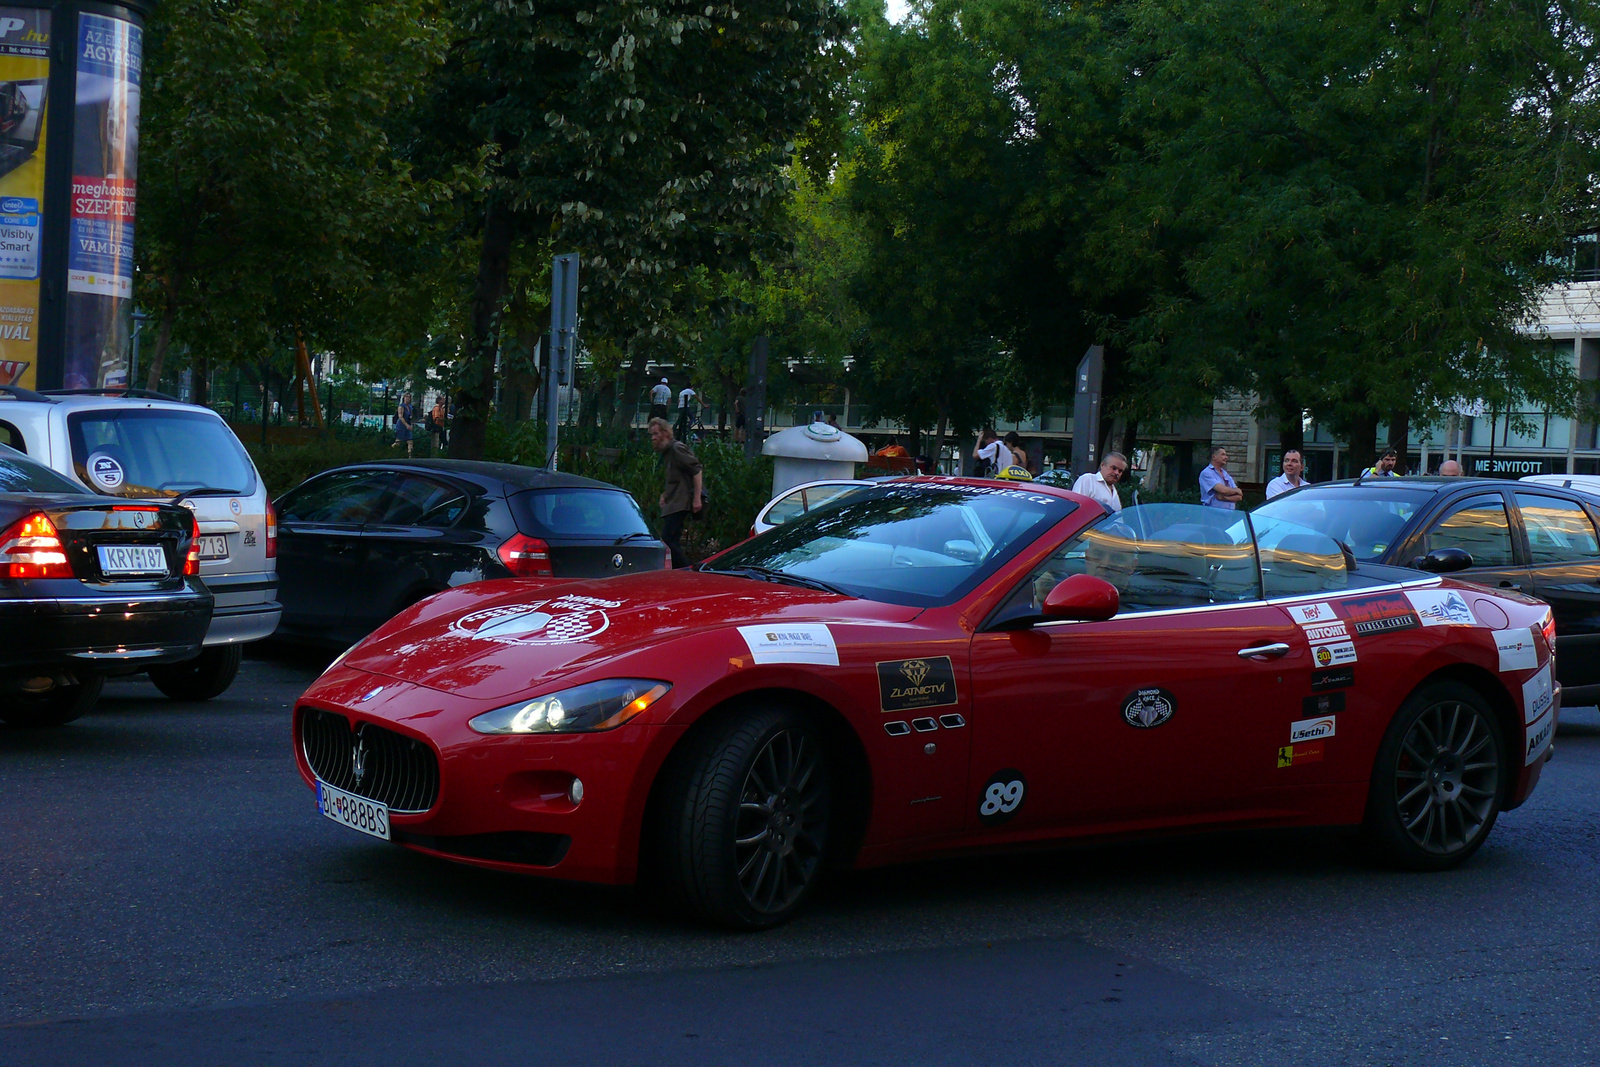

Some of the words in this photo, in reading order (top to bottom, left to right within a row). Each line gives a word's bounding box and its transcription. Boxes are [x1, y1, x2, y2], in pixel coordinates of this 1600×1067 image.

[1, 229, 34, 242] Visibly
[1, 242, 30, 252] Smart
[1008, 469, 1030, 478] TAXI
[1475, 459, 1543, 474] MEGNYITOTT
[199, 537, 225, 555] 713
[1302, 604, 1321, 620] hey!
[1355, 620, 1384, 633] FITNESS
[1387, 615, 1414, 628] CENTER
[1306, 625, 1348, 640] AUTOHIT
[1317, 651, 1331, 661] 301
[890, 682, 946, 698] ZLATNICTVÍ
[980, 780, 1024, 816] 89
